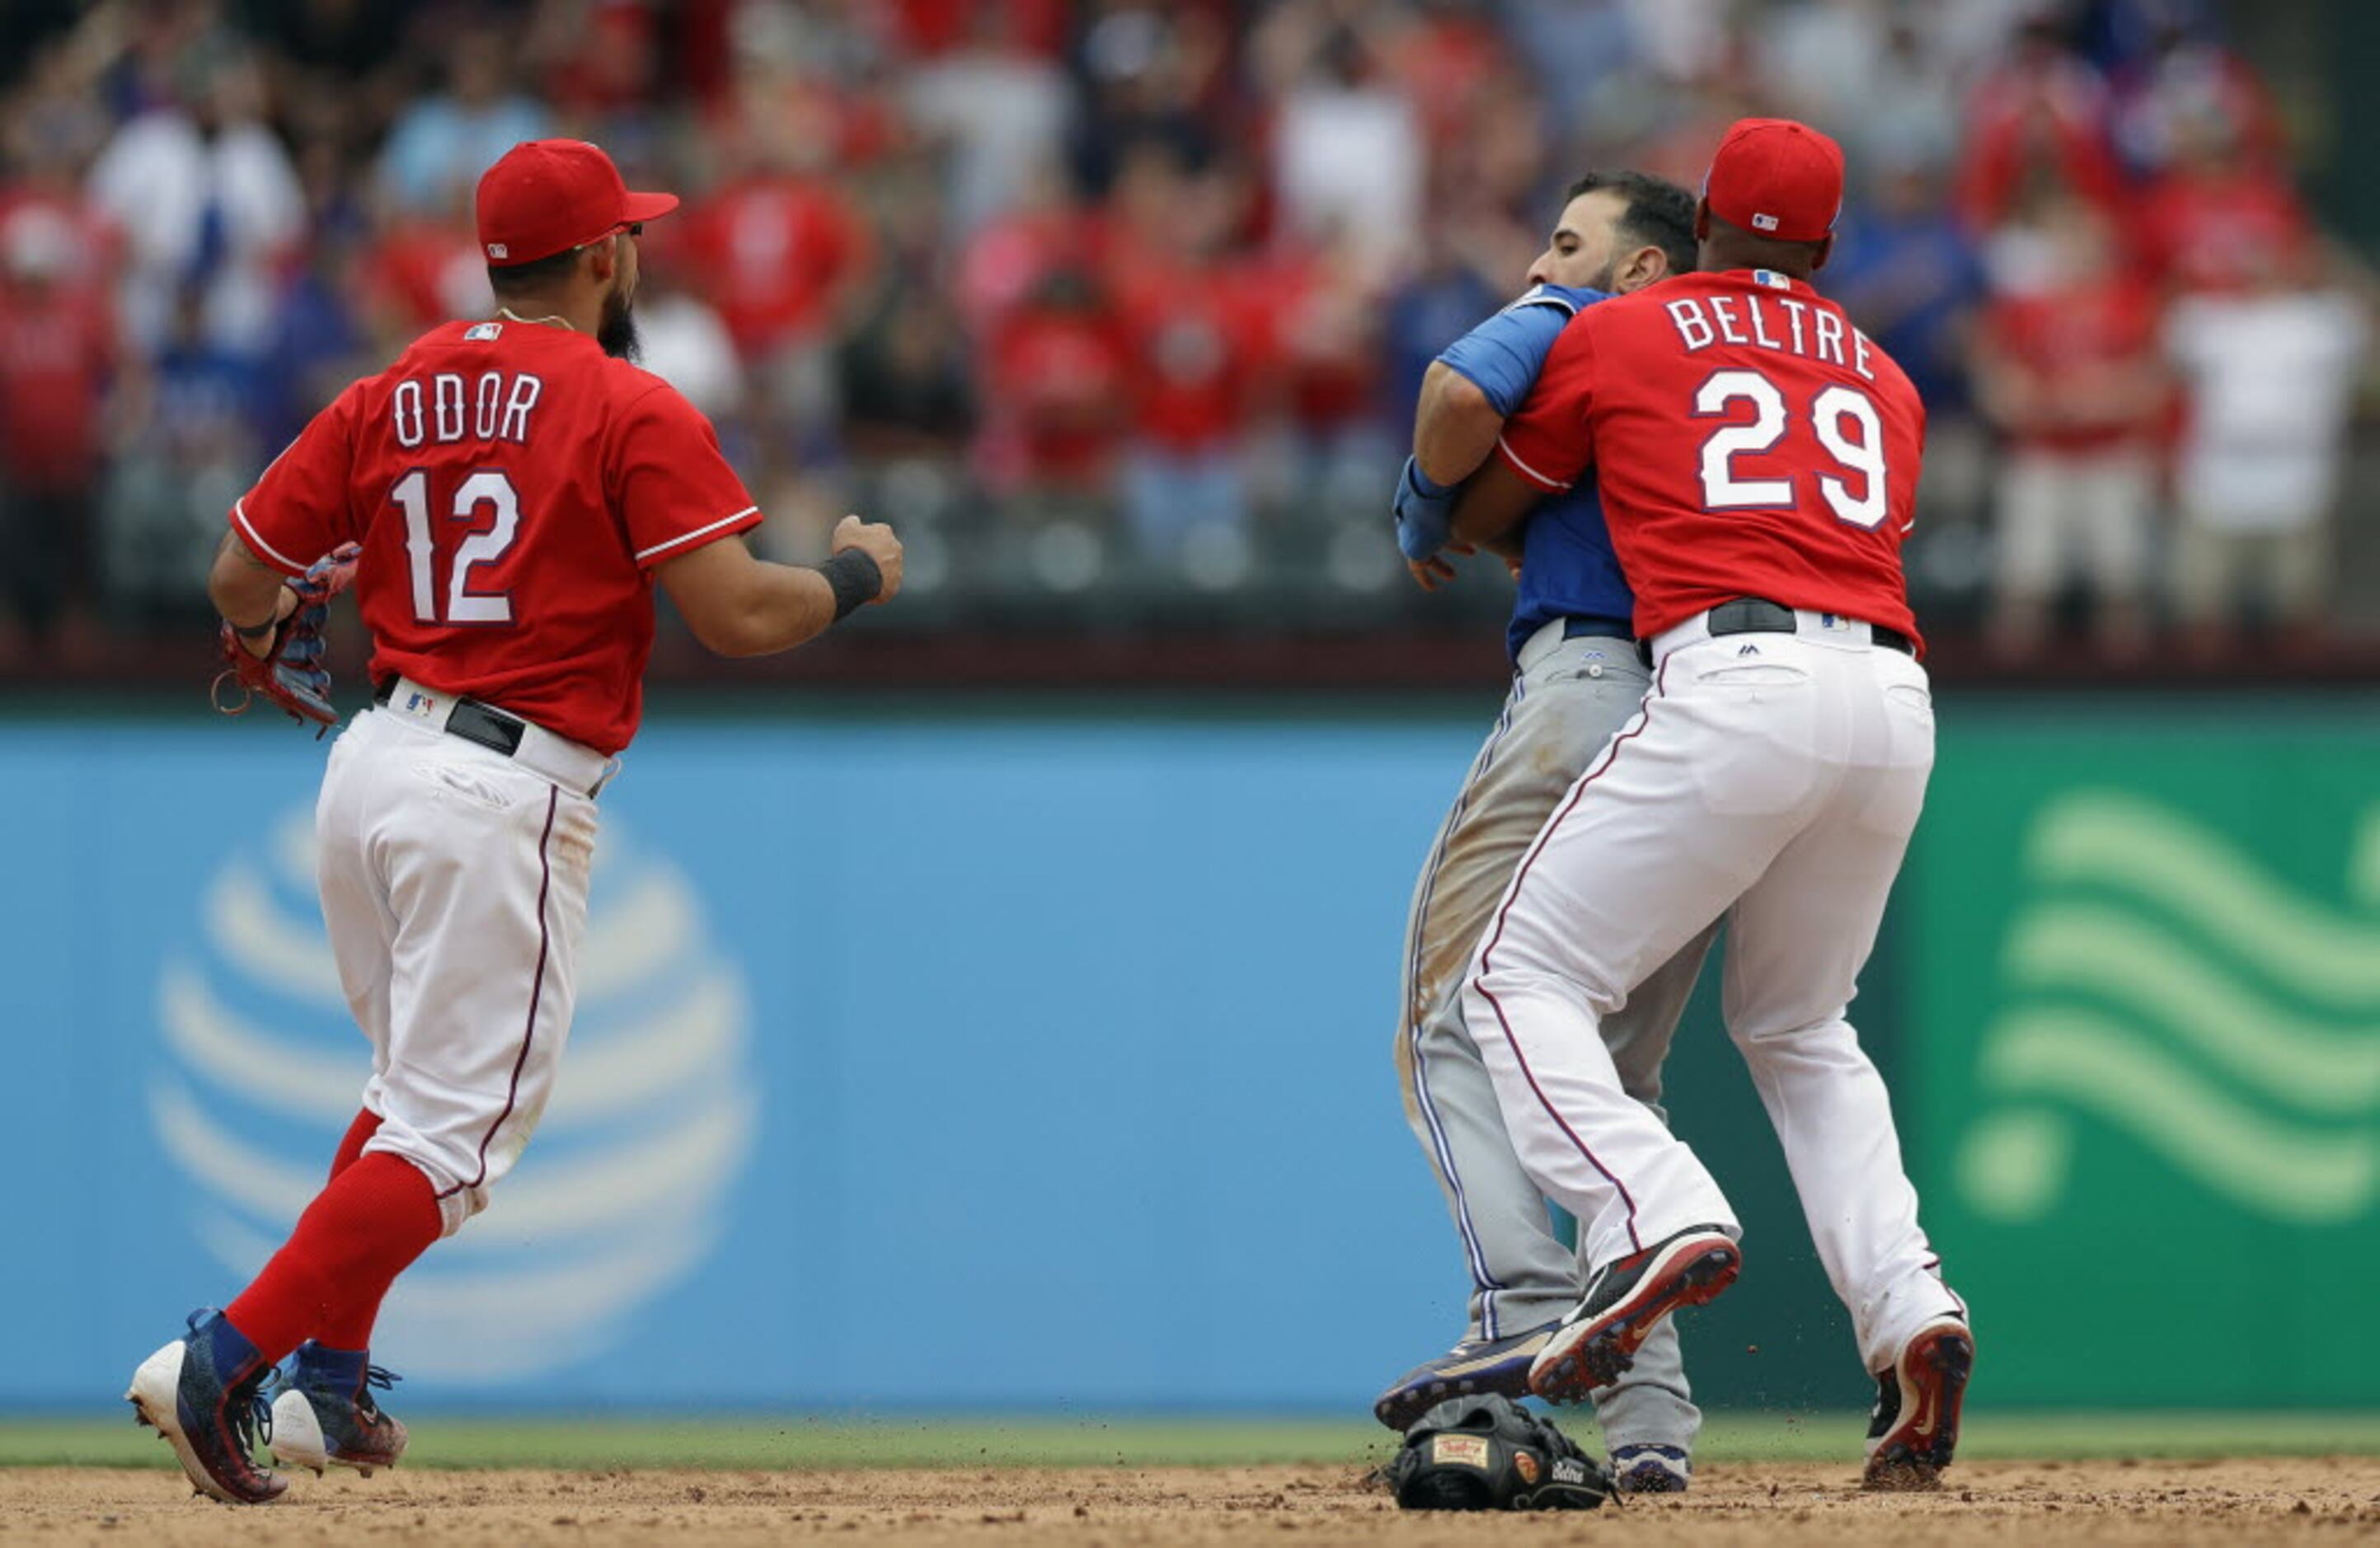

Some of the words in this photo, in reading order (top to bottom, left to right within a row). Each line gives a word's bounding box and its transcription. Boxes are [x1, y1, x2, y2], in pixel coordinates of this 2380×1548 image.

[1665, 293, 1875, 381] BELTRE
[394, 372, 542, 448] ODOR
[1692, 367, 1889, 532] 29
[390, 467, 523, 626] 12
